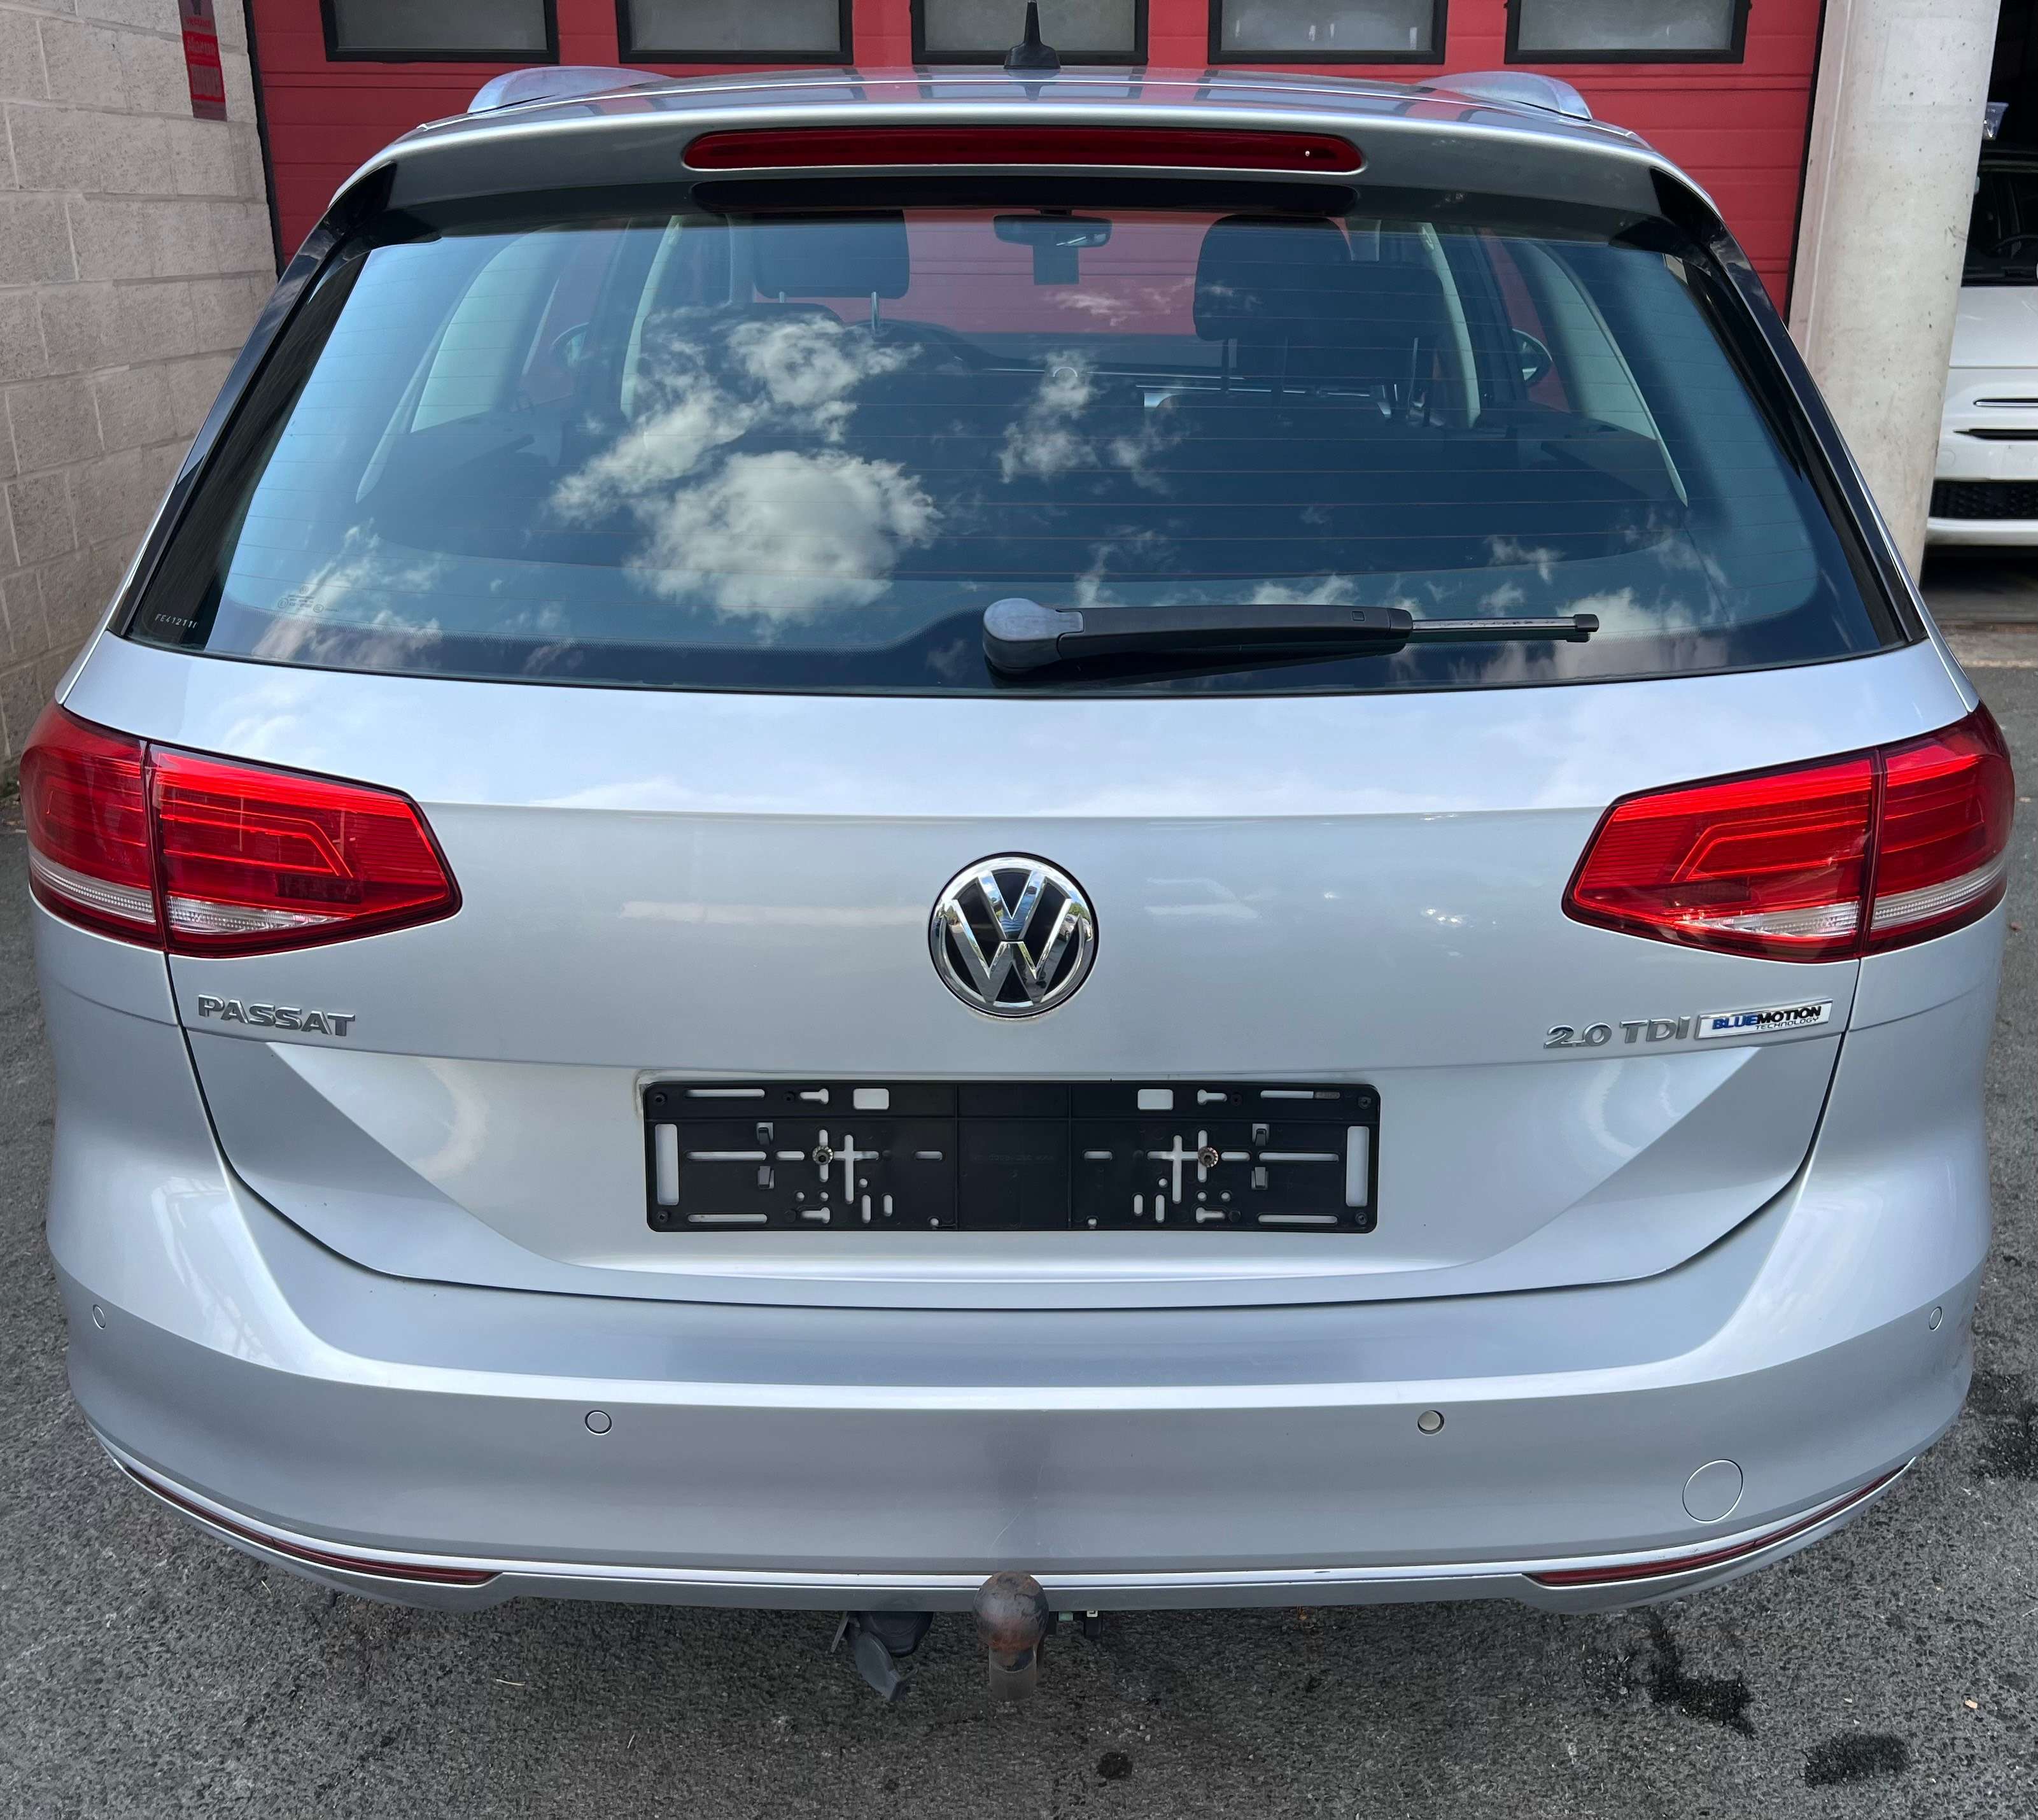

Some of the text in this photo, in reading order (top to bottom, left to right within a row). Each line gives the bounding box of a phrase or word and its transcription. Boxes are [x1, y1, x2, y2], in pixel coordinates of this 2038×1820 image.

[198, 993, 355, 1036] PASSAT
[1712, 1006, 1822, 1029] BLUEMOTION
[1755, 1017, 1819, 1029] TECHNOLOGY
[1543, 1016, 1690, 1048] 2.0 TDI
